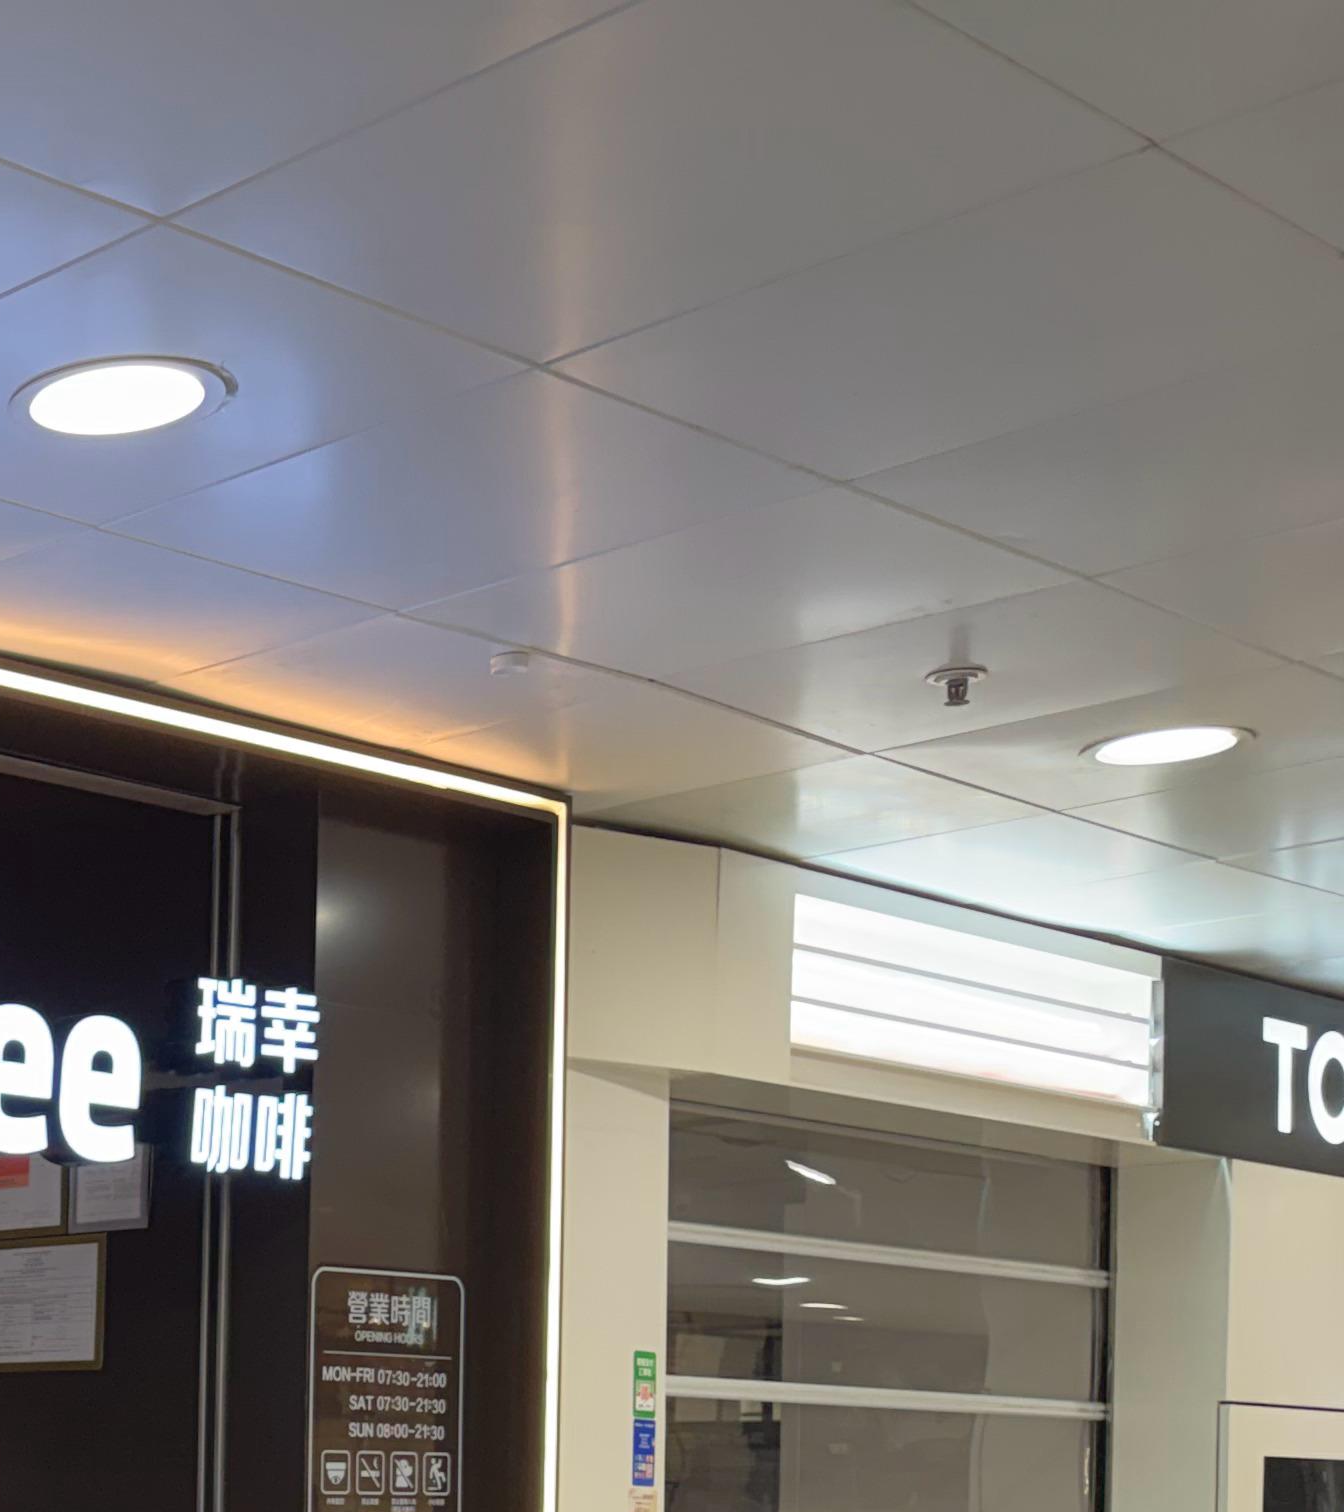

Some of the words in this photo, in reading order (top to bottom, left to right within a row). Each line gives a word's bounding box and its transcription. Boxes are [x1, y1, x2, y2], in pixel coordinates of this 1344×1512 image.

[196, 977, 320, 1073] 瑞幸
[190, 1085, 313, 1180] 咖啡
[348, 1291, 431, 1328] 營業時間
[355, 1330, 392, 1343] OPENING
[394, 1332, 423, 1345] HOURS
[322, 1366, 374, 1382] MON-FRI
[378, 1369, 447, 1387] 07:30-21:00
[349, 1395, 374, 1410] SAT
[377, 1396, 446, 1414] 07:30-21:30
[348, 1422, 373, 1437] SUN
[376, 1423, 445, 1440] 08:00-21:30
